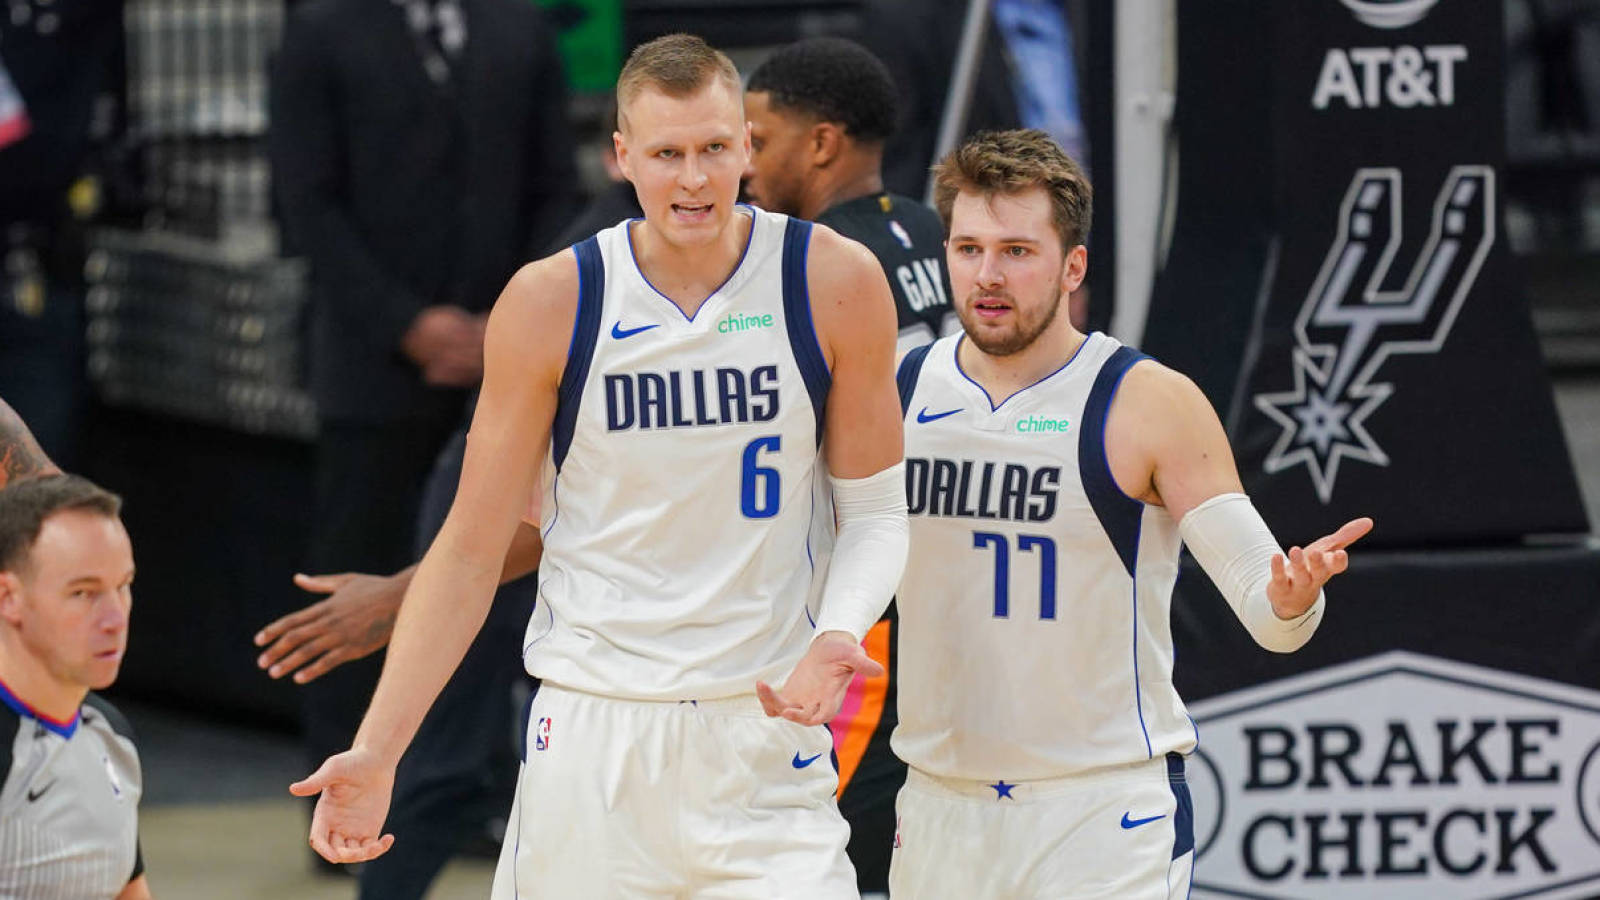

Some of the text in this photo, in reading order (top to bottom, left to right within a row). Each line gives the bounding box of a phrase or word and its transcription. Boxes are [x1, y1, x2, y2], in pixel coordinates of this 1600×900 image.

[1312, 44, 1467, 109] AT&T
[896, 257, 947, 312] GAY
[718, 312, 774, 334] chime
[604, 365, 780, 432] DALLAS
[1016, 415, 1069, 432] chime
[740, 434, 782, 519] 6
[905, 457, 1062, 523] DALLAS
[972, 530, 1057, 620] 77
[1242, 719, 1561, 791] BRAKE
[1241, 808, 1557, 881] CHECK
